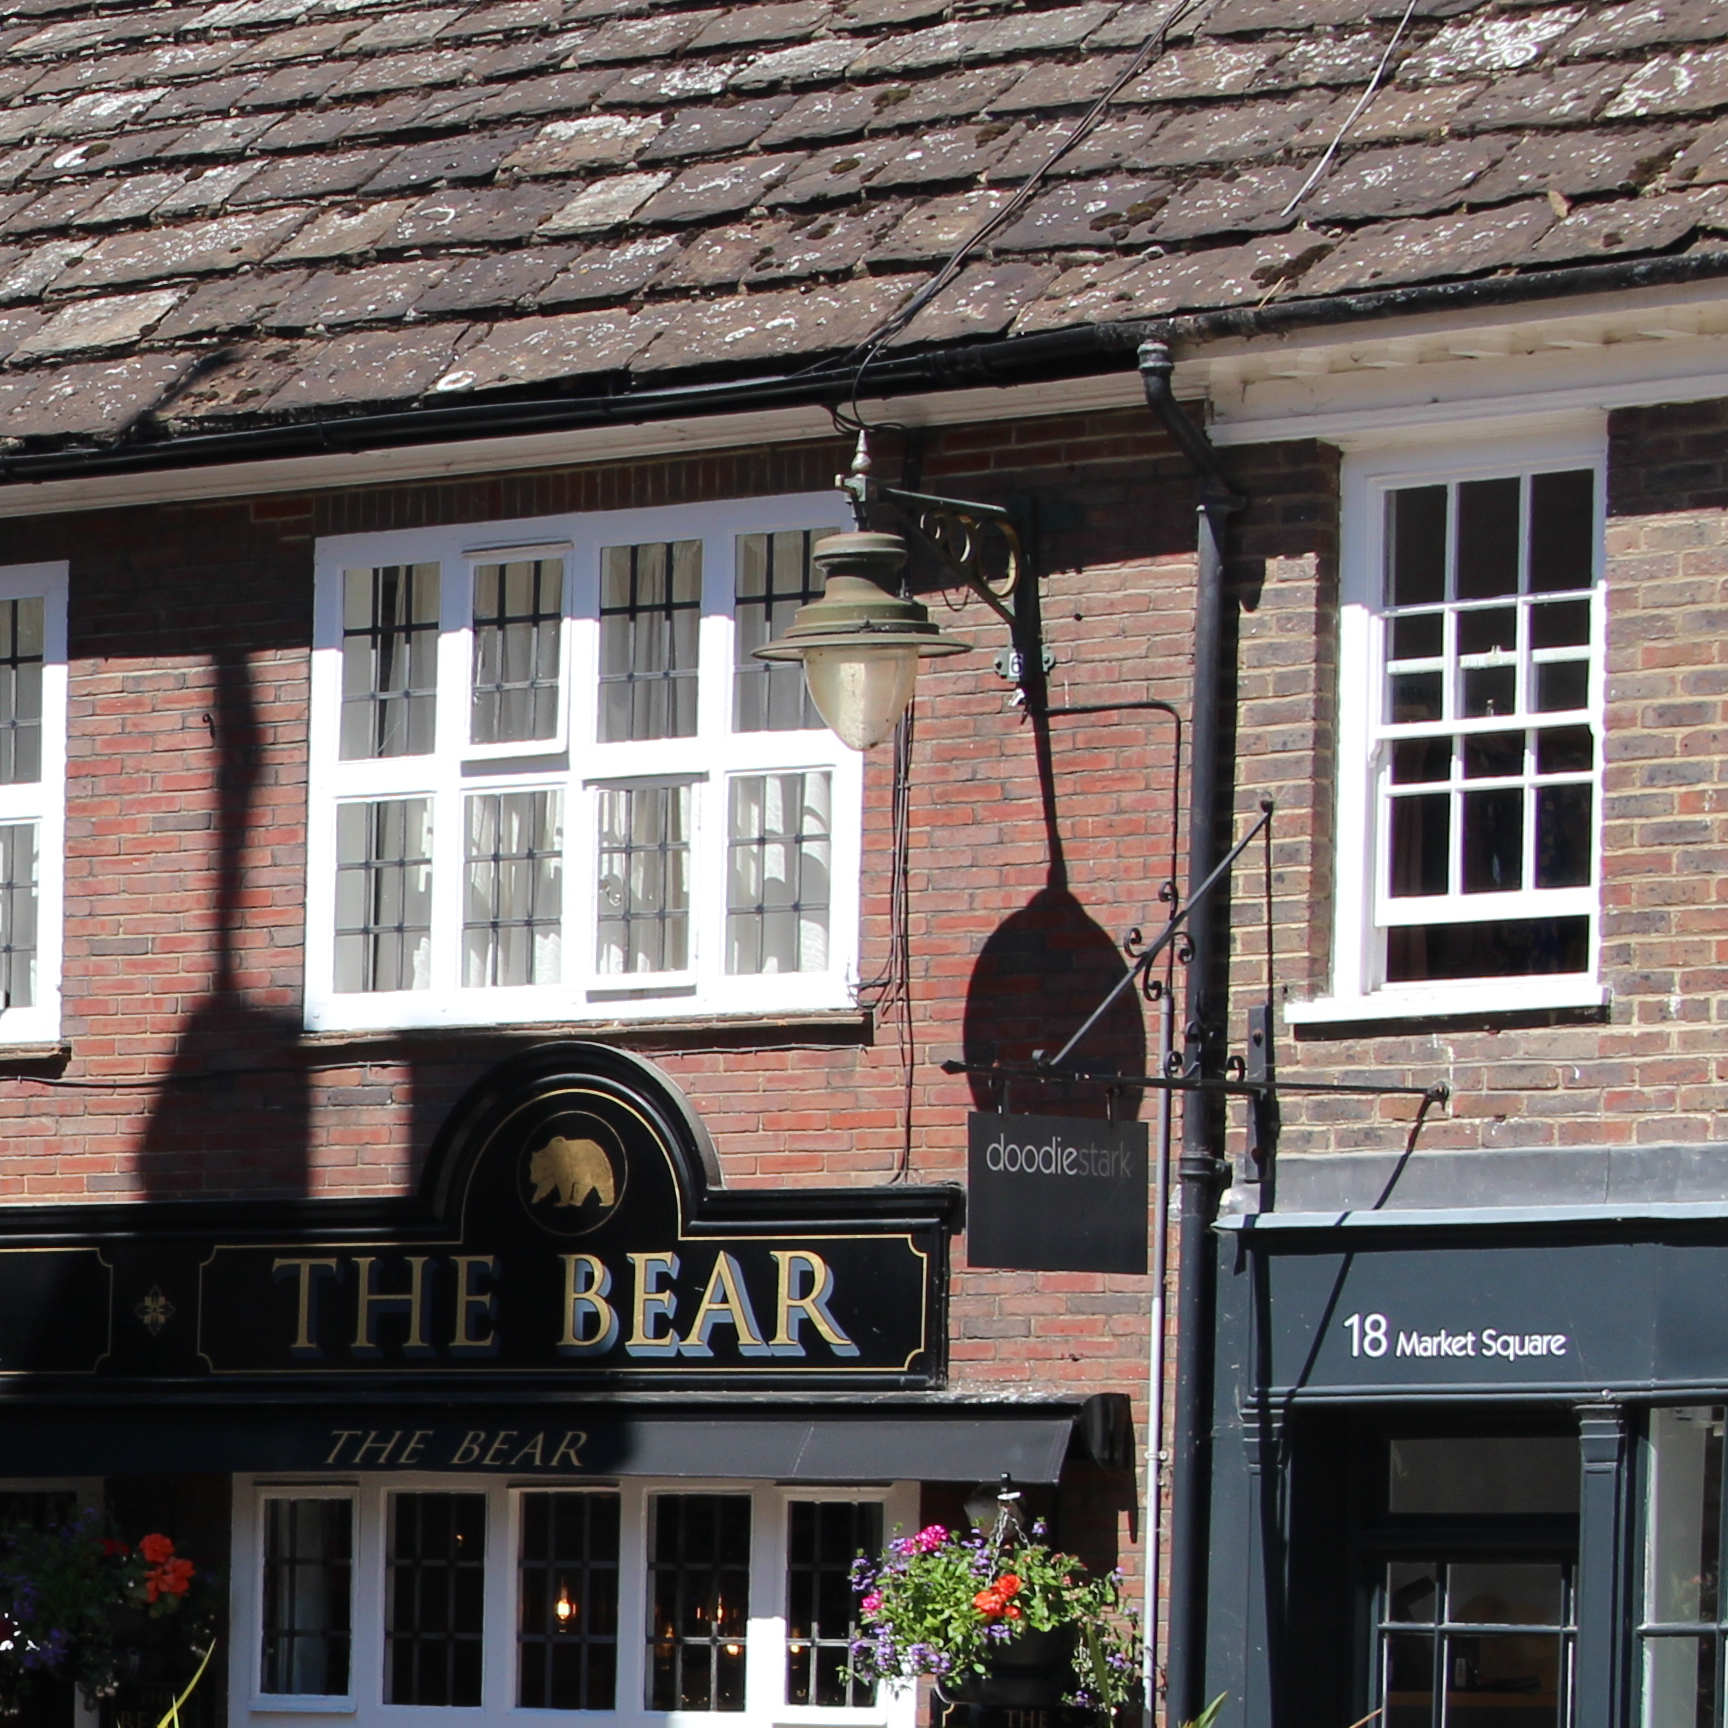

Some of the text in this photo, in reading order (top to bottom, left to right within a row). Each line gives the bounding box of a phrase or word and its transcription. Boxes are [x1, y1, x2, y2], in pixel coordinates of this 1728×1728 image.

[1011, 655, 1022, 674] 6
[986, 1133, 1131, 1178] doodiestark
[272, 1250, 861, 1359] THE BEAR
[1343, 1312, 1566, 1361] 18 Market Square
[323, 1429, 588, 1468] THE BEAR
[1003, 1709, 1049, 1728] THE
